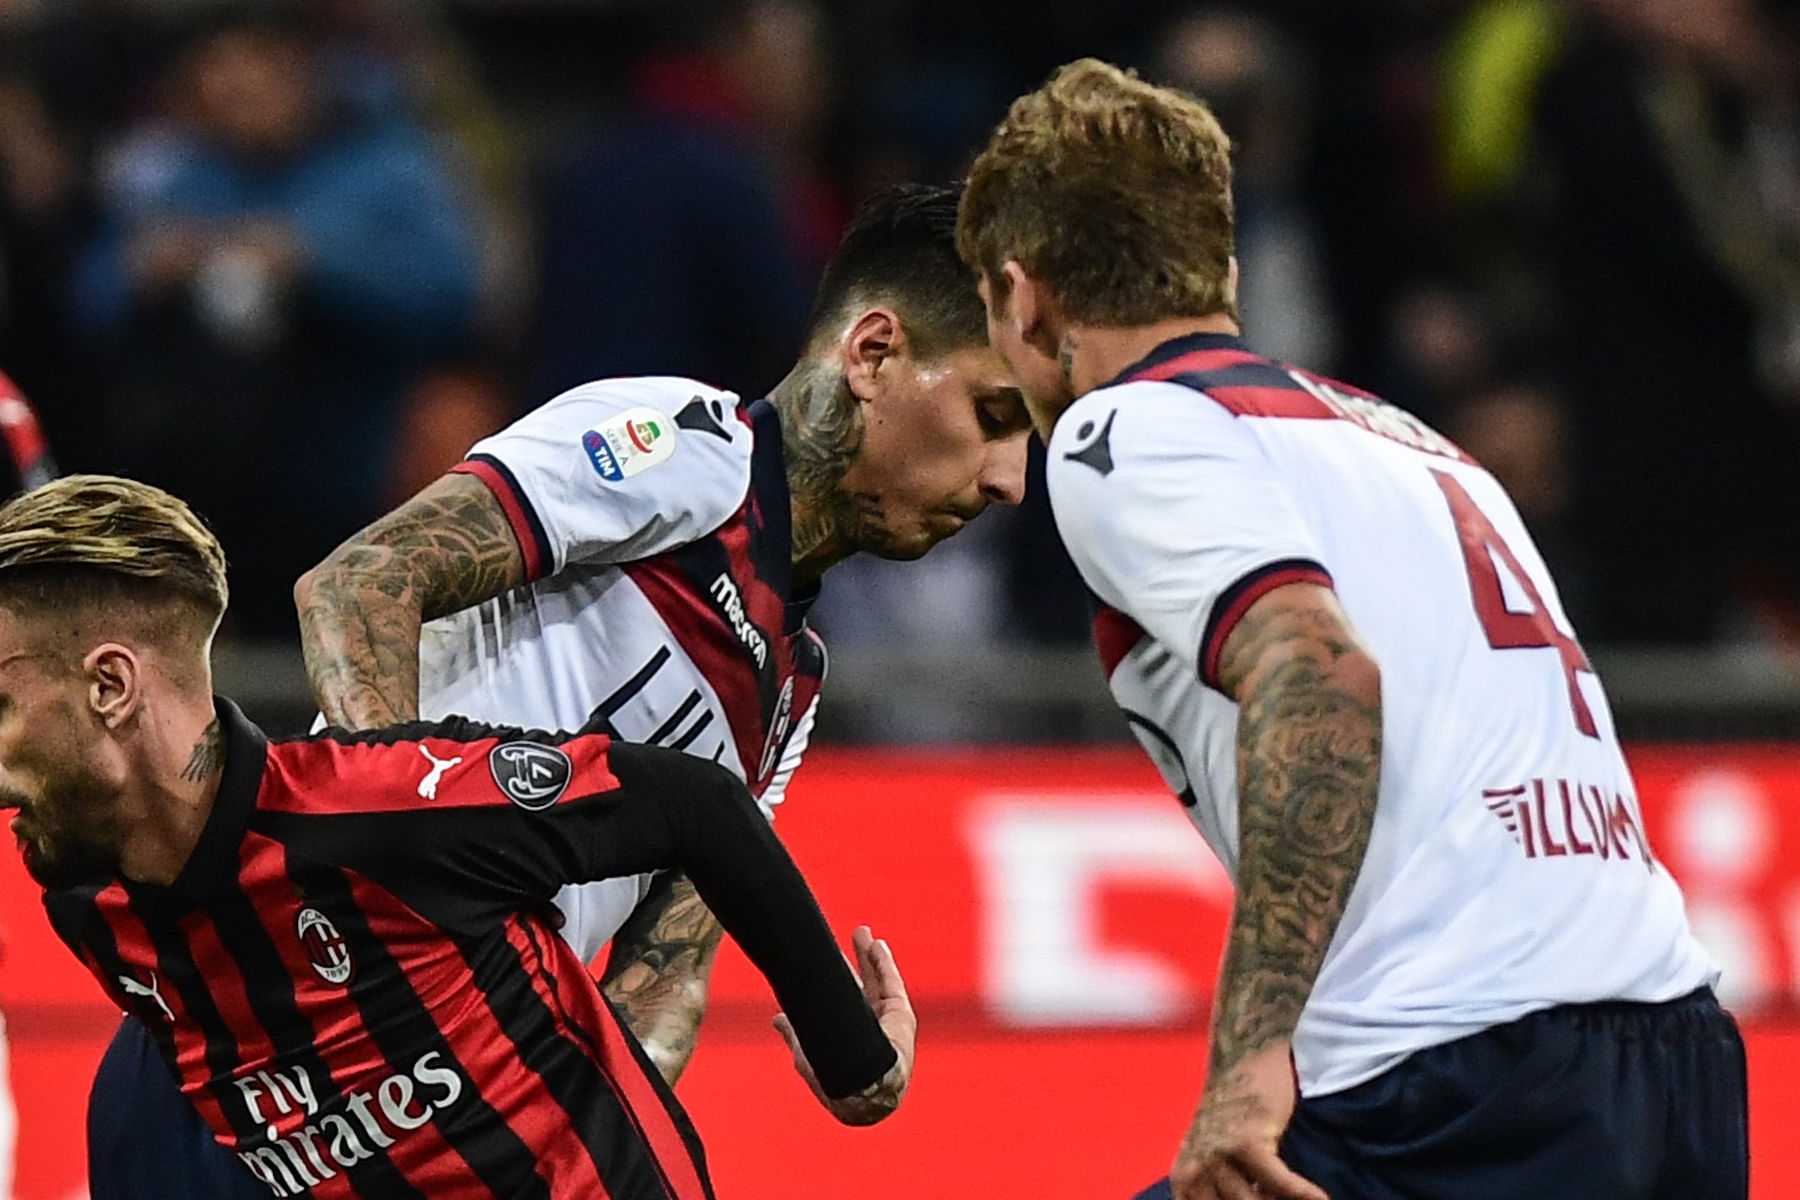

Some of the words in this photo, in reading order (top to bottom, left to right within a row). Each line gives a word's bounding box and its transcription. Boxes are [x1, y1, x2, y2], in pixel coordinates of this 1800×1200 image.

[594, 446, 616, 477] TIM
[1427, 466, 1602, 742] 4
[233, 1065, 318, 1124] Fly
[237, 1050, 462, 1198] mirates
